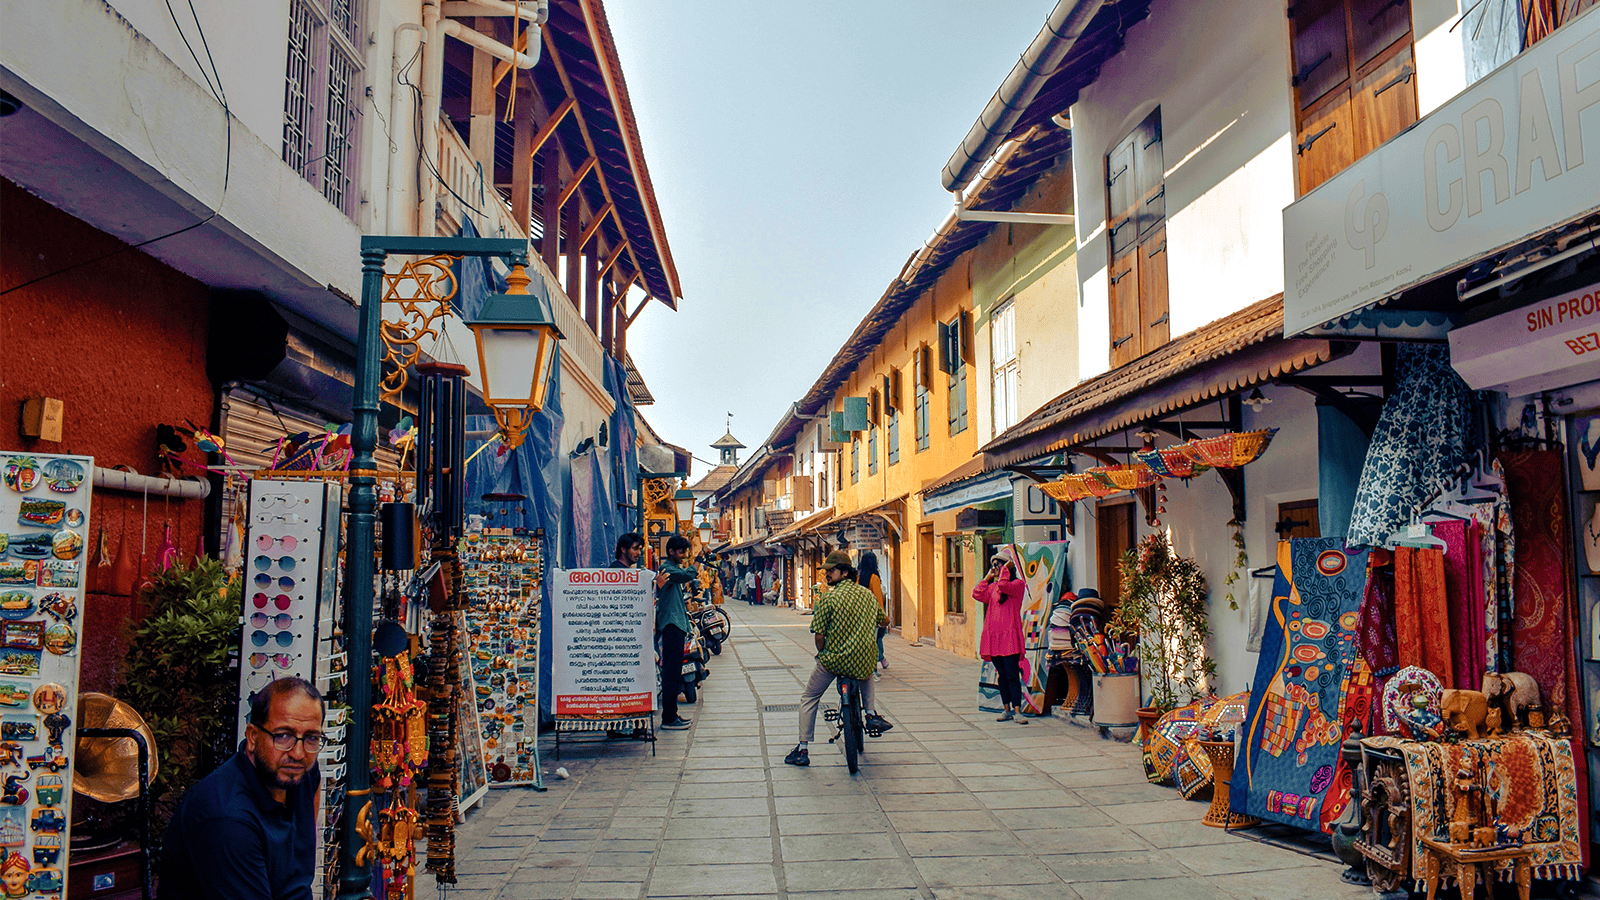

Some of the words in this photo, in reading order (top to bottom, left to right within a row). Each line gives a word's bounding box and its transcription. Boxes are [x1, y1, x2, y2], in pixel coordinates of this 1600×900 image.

[1304, 232, 1318, 252] Feel
[1308, 234, 1330, 260] Hassle
[1308, 238, 1338, 274] Shopping
[1298, 260, 1330, 298] Experience
[1526, 306, 1554, 332] SIN
[569, 570, 640, 583] അറിയിപ്പ്
